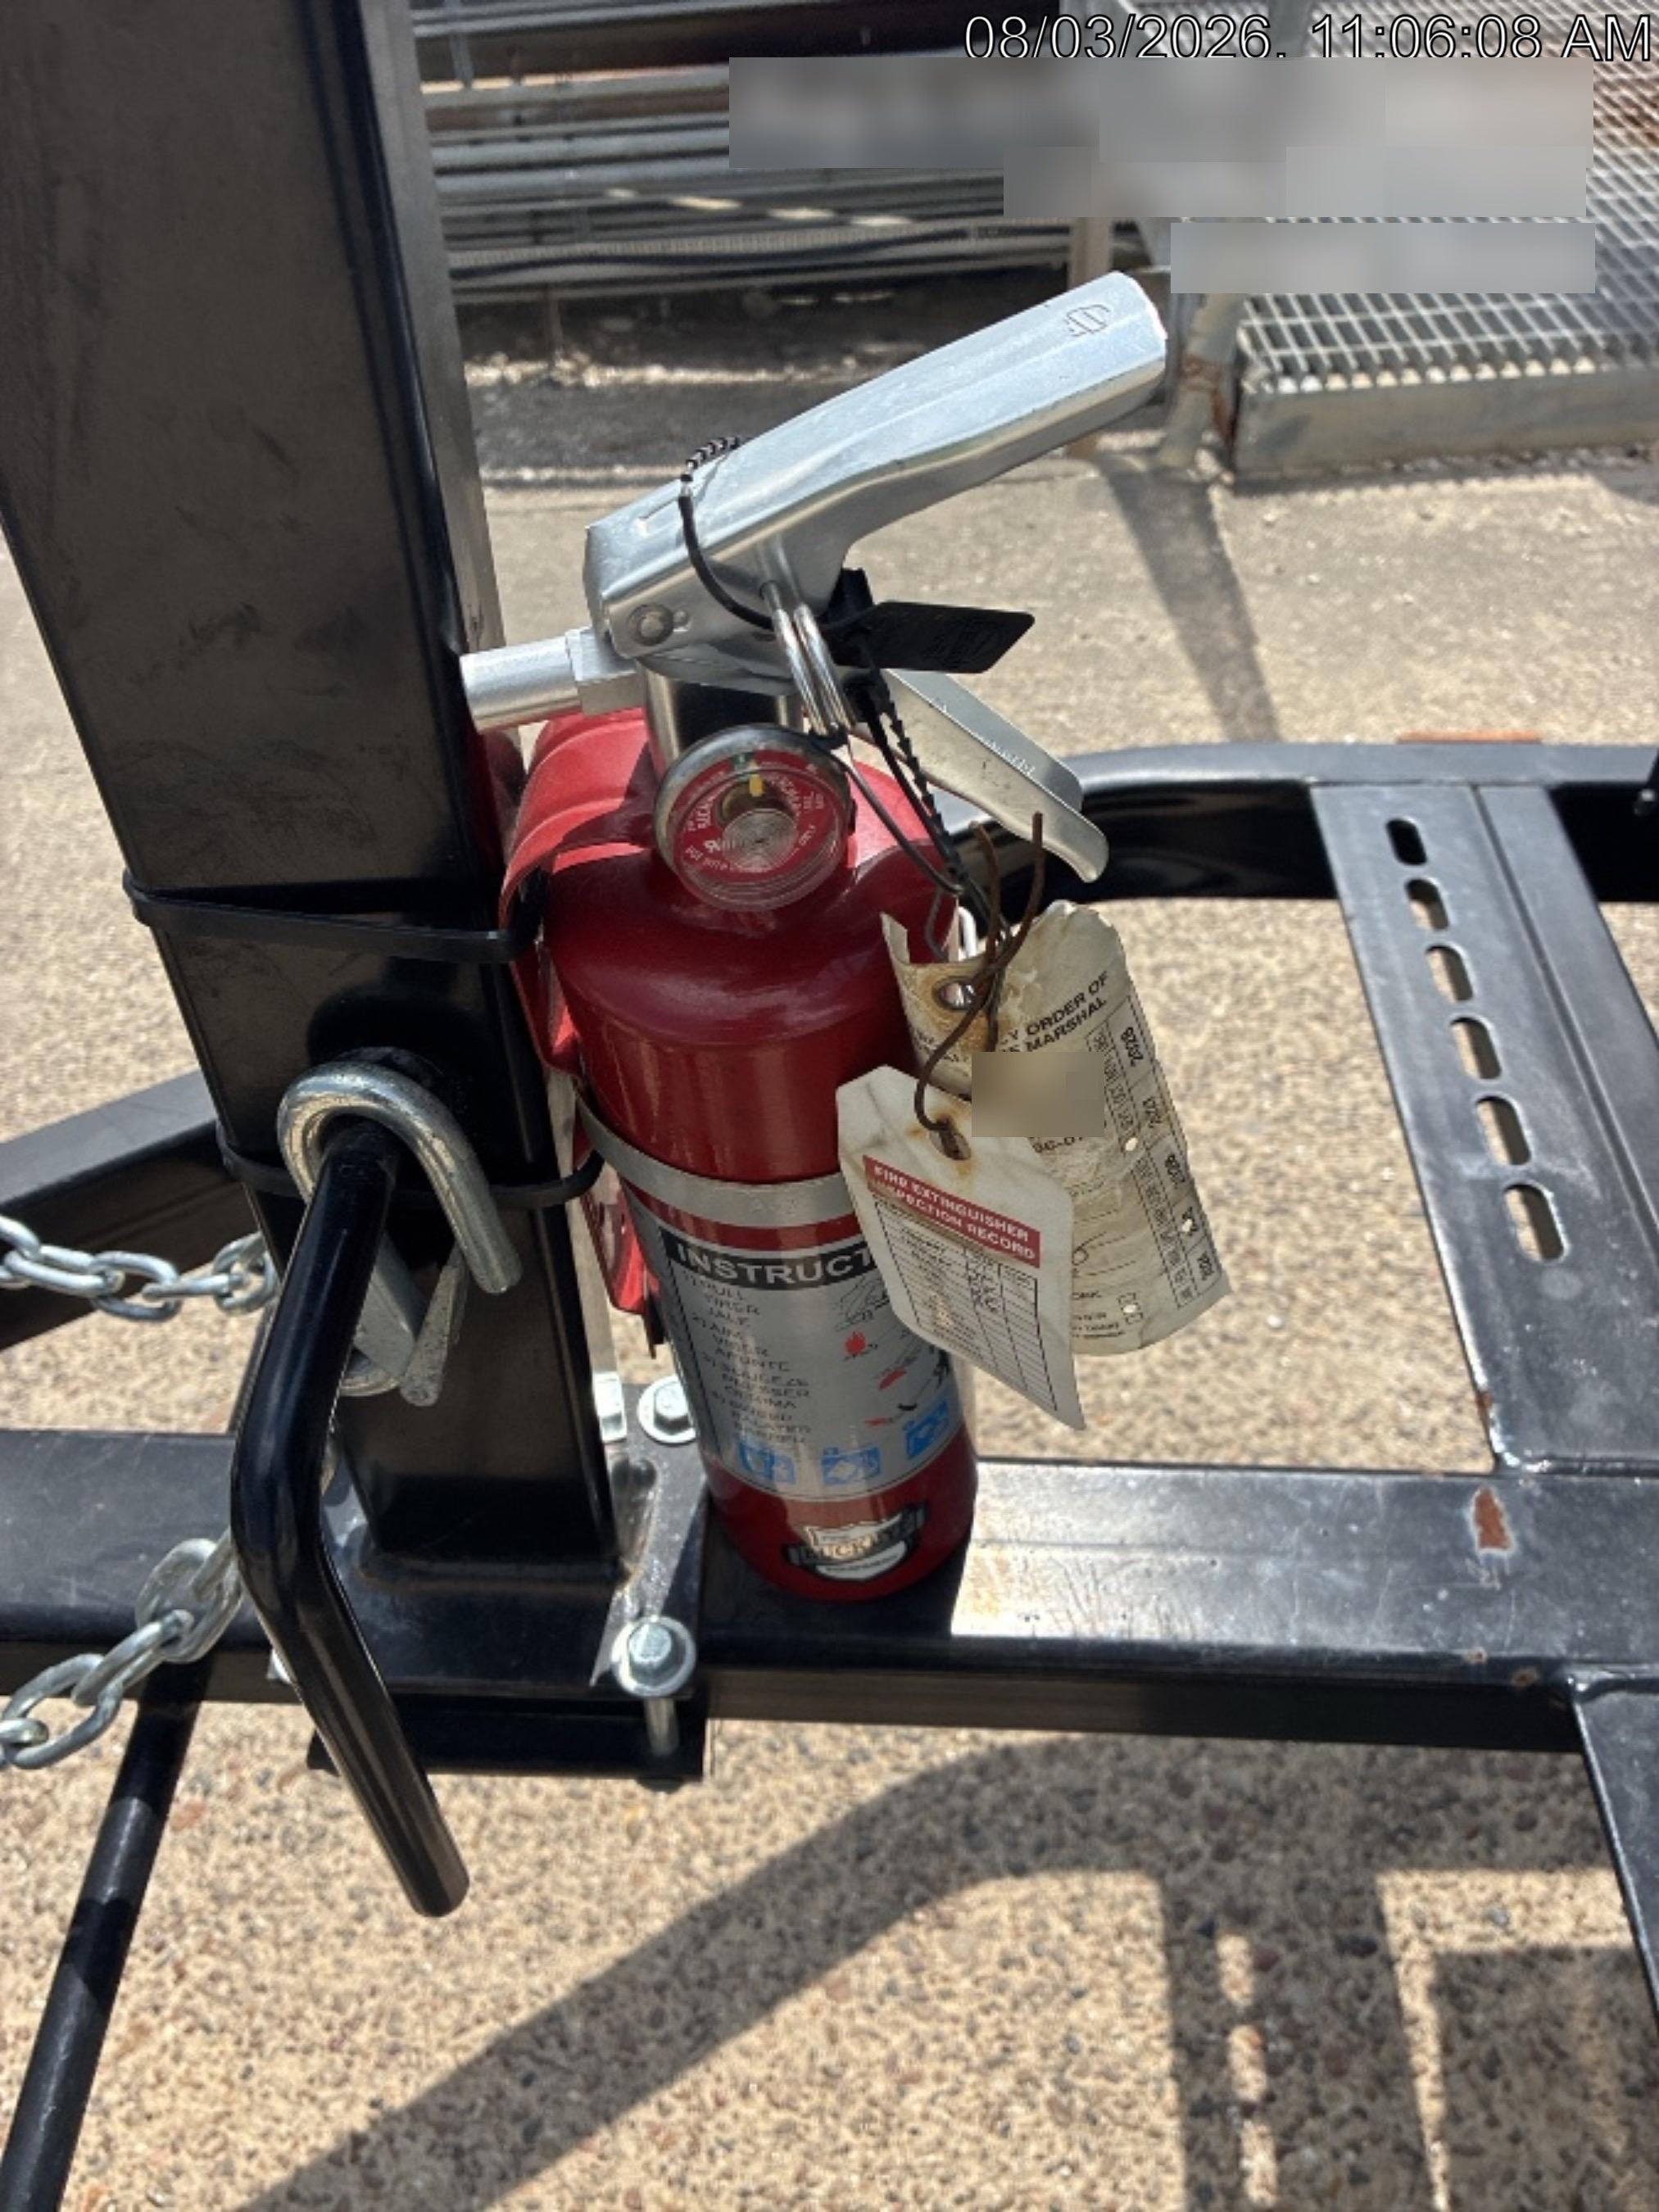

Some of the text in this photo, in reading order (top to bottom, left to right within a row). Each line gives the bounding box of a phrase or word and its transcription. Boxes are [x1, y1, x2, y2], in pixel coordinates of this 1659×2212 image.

[1026, 997, 1107, 1052] MARSHAL
[1027, 992, 1086, 1036] ORDER
[1088, 970, 1108, 996] OF
[873, 1164, 909, 1188] FIRE
[912, 1185, 1030, 1242] EXTINGUISHER
[966, 1222, 1036, 1260] RECORD
